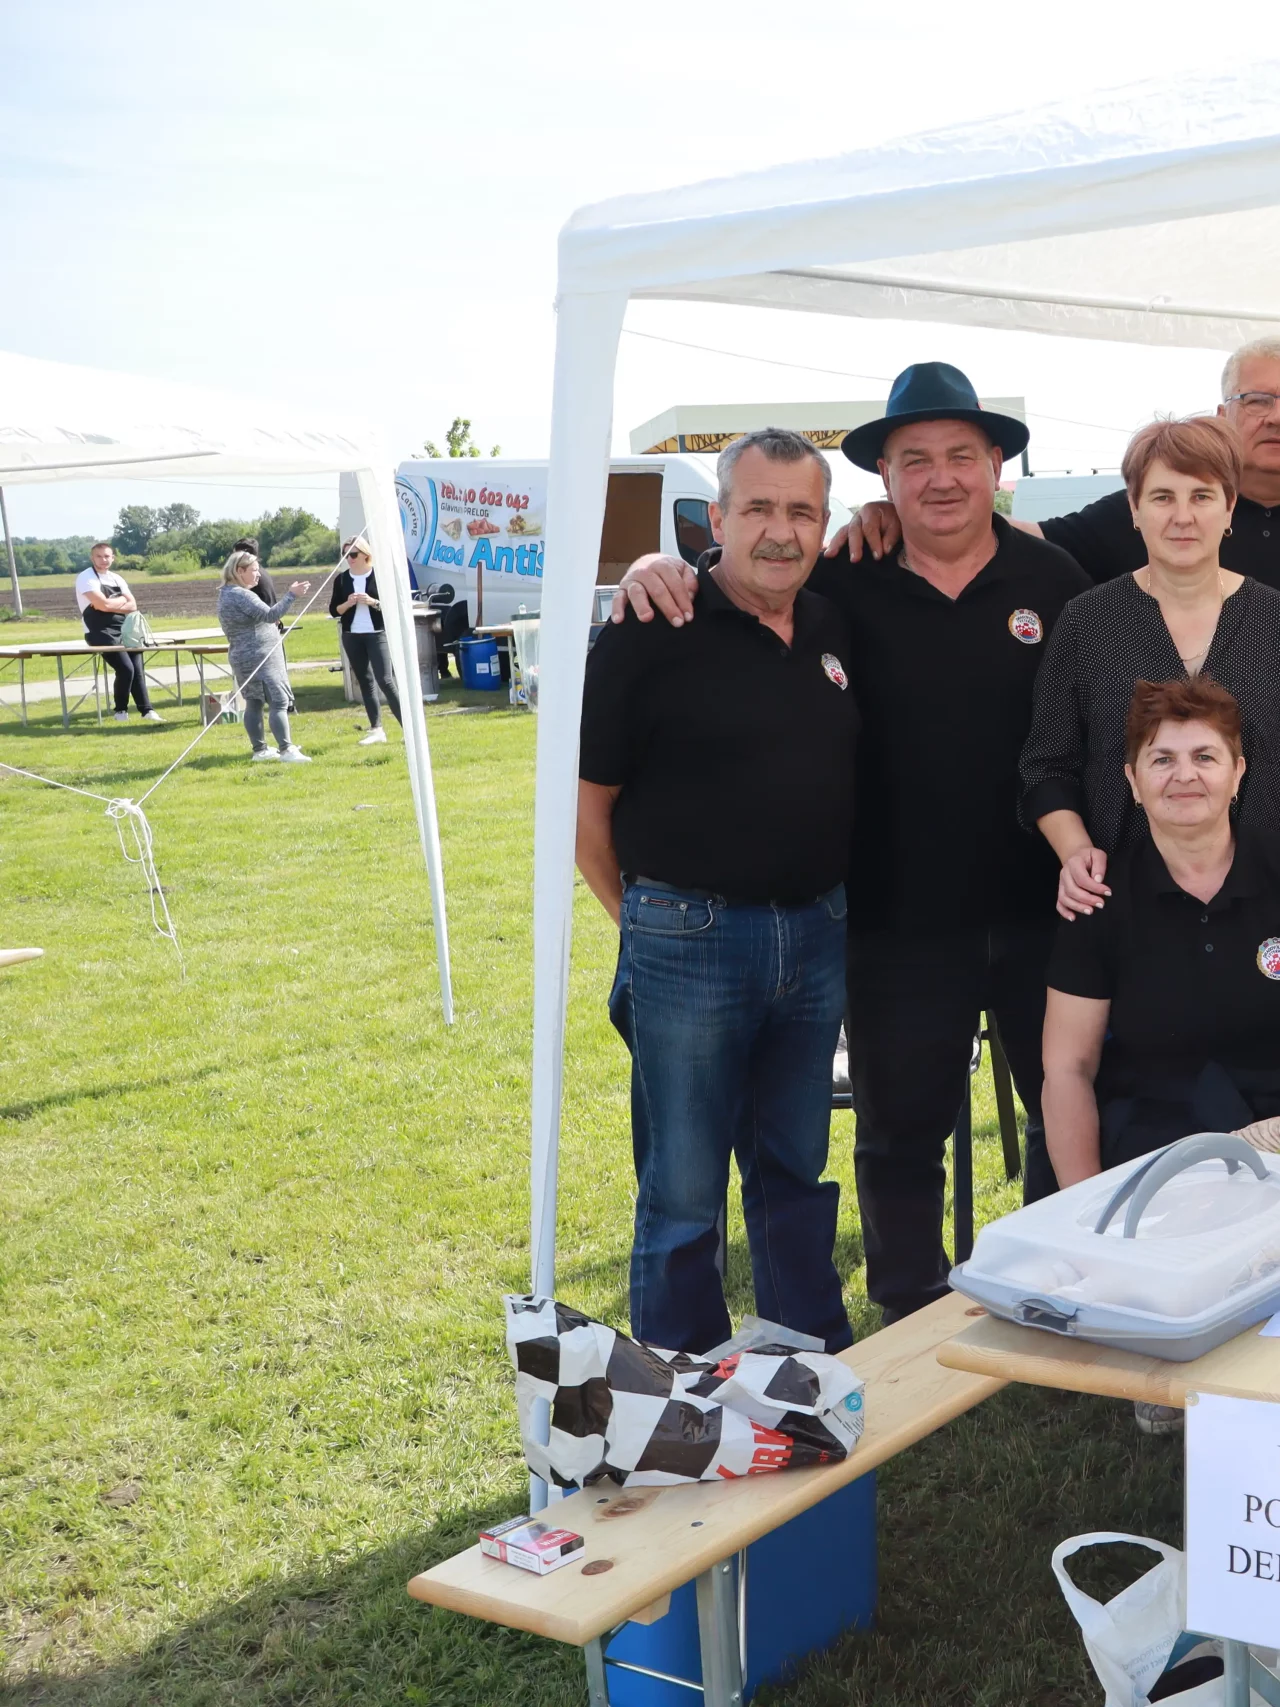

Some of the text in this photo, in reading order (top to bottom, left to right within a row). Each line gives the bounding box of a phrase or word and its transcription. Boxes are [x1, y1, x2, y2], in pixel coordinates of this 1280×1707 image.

[400, 491, 418, 537] Catering
[478, 487, 503, 506] 602
[505, 493, 530, 512] 042
